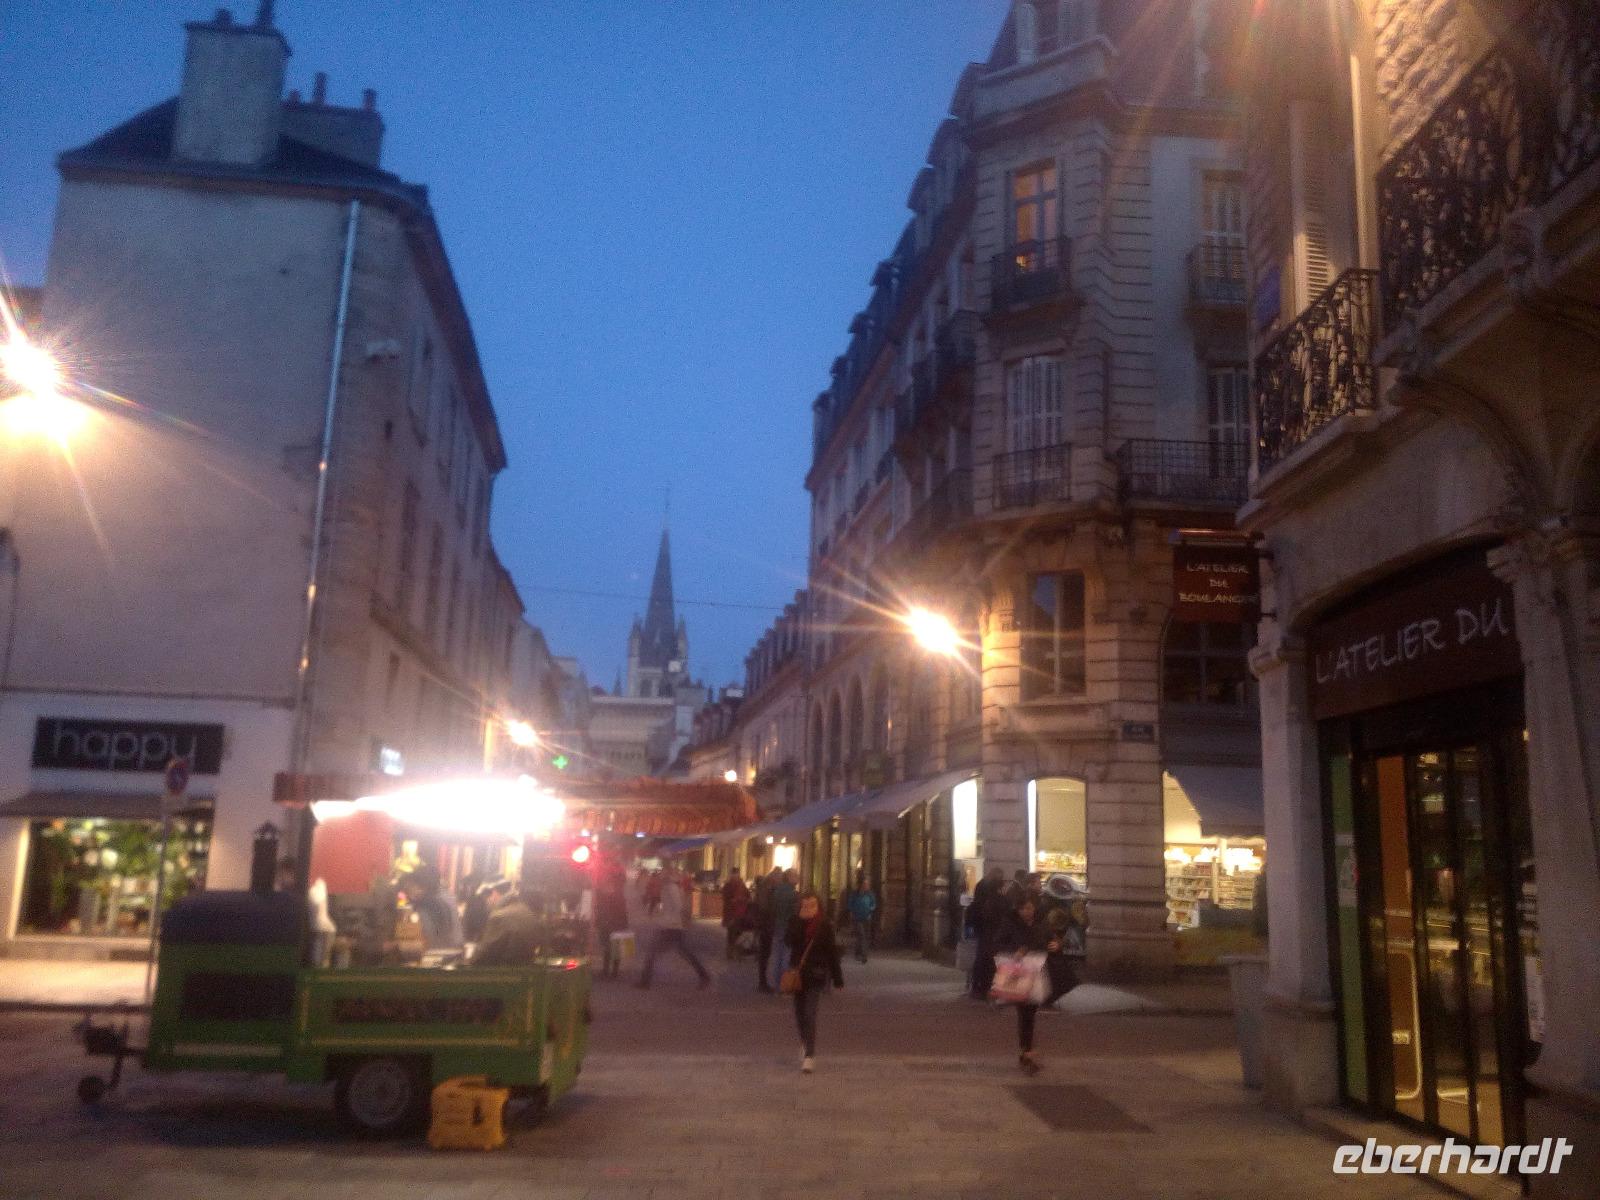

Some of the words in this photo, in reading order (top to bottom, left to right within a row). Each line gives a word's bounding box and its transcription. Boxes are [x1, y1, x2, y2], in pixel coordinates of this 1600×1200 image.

[1208, 579, 1229, 588] DU
[1315, 616, 1445, 685] L'ATELIER
[1455, 598, 1509, 645] DU
[53, 721, 197, 769] happy
